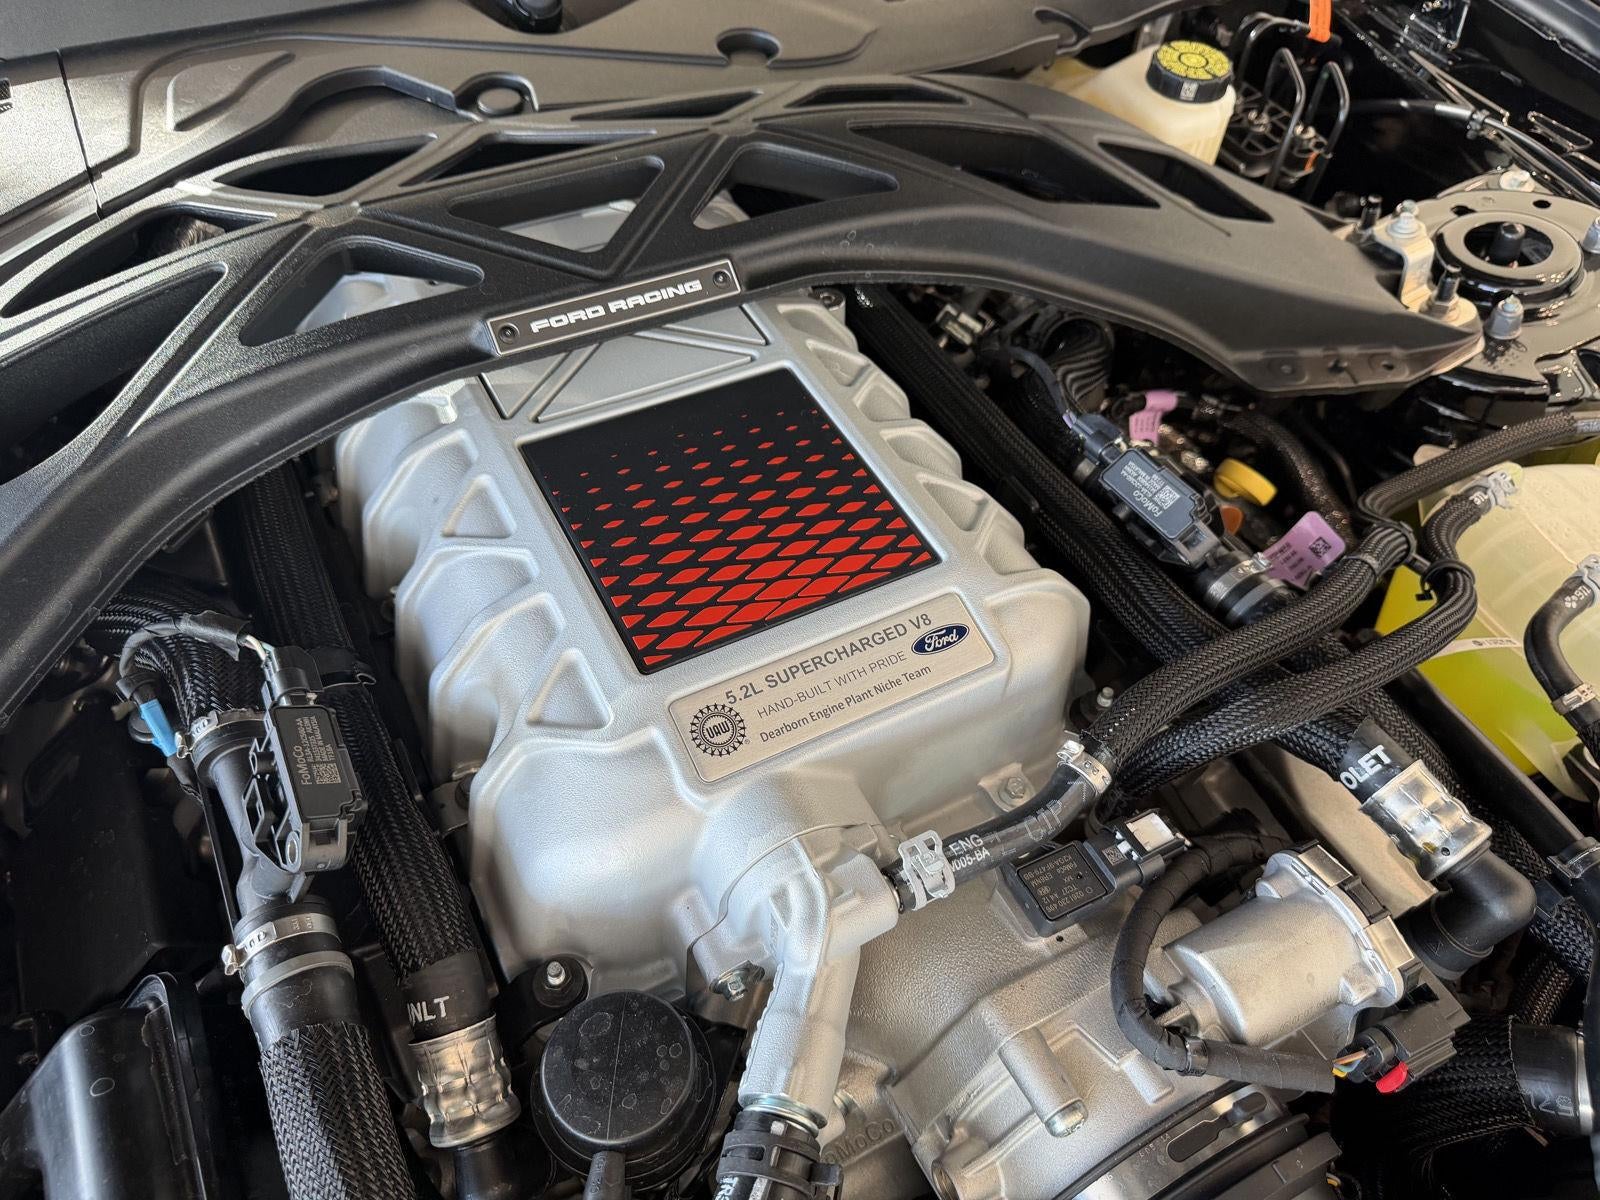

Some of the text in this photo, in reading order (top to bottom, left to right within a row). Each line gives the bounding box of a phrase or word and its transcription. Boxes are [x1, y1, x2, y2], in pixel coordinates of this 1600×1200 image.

[530, 281, 702, 333] FORD RACING
[1132, 489, 1162, 517] FoMoCo
[725, 613, 931, 705] 5.2L SUPERCHARGED V8
[924, 629, 960, 652] Ford
[757, 651, 907, 719] HAND-BUILT WITH PRIDE
[759, 664, 931, 743] Dearborn Engine Plant Niche Team
[705, 721, 731, 739] UAW
[292, 745, 313, 785] FoMoCo
[950, 833, 983, 854] ENG
